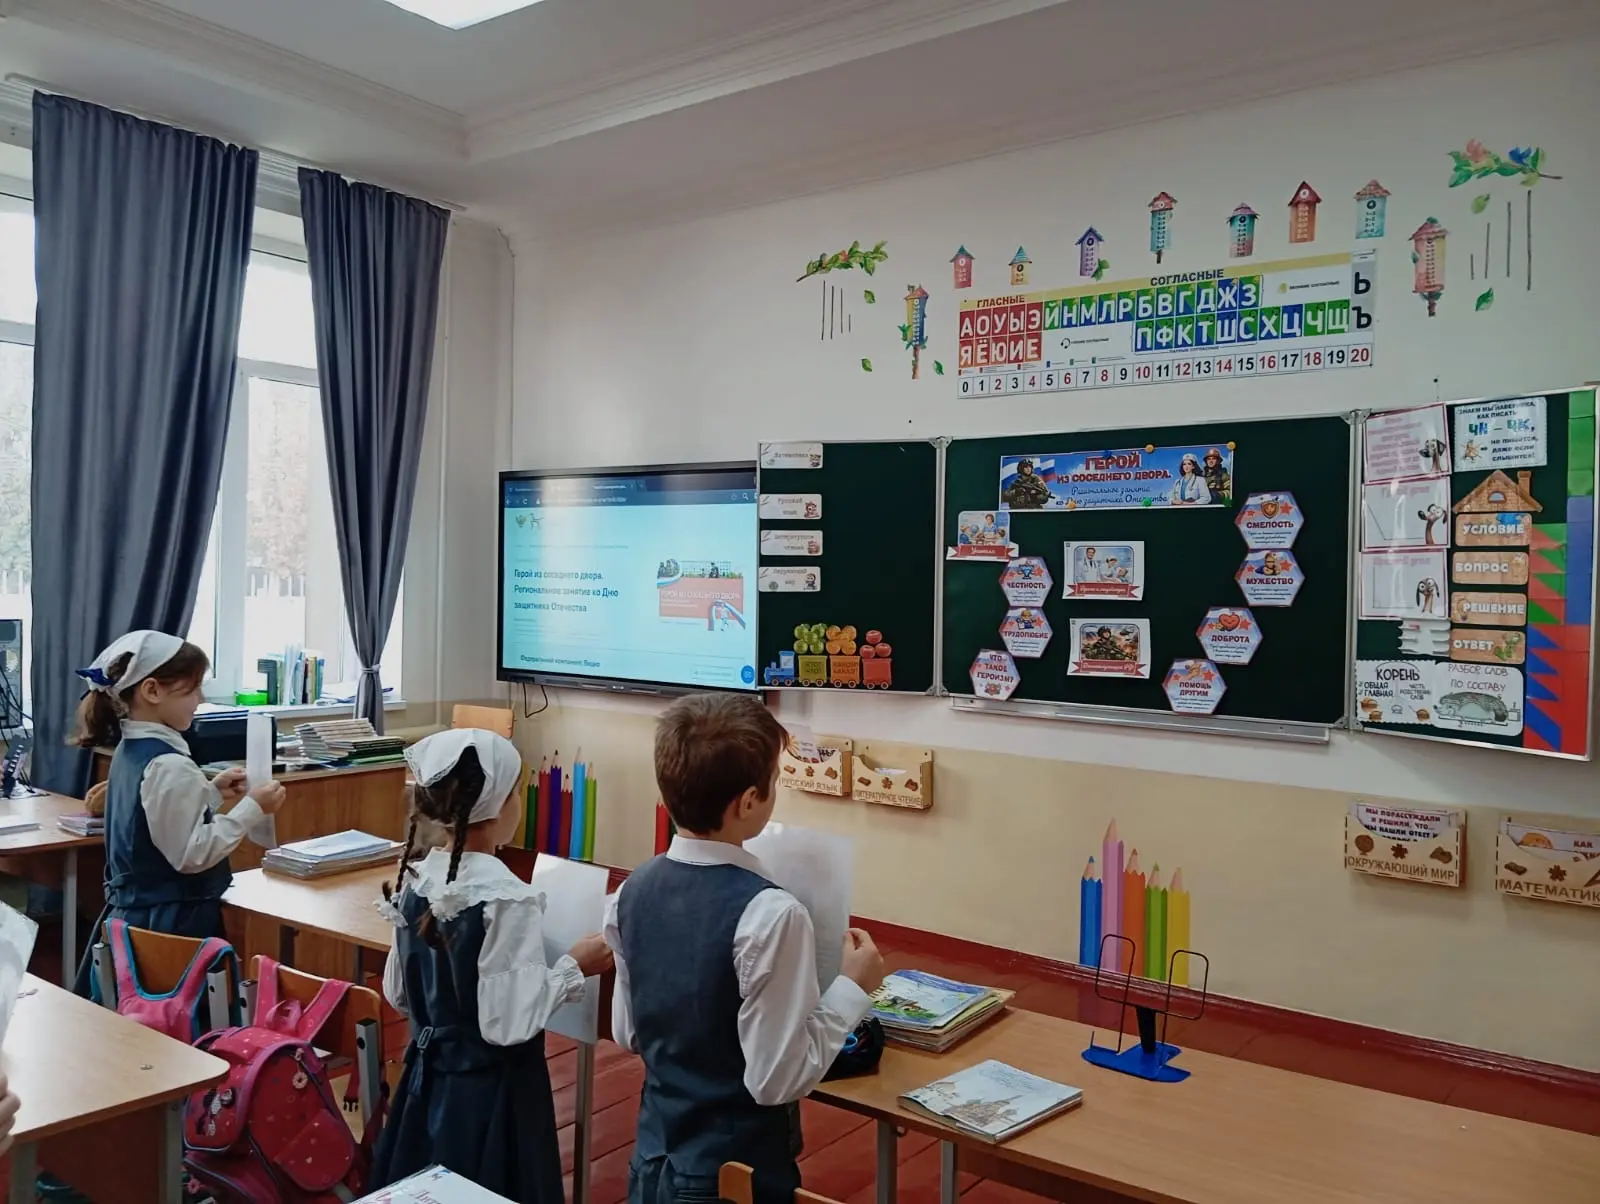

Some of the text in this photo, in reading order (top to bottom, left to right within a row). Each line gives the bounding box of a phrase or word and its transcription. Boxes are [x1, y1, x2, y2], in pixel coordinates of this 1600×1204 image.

[1151, 269, 1224, 286] СОГЛАСНЫЕ
[977, 295, 1025, 308] ГЛАСНЫЕ
[963, 348, 1369, 392] 0 1 2 3 4 5 6 7 8 9 10 11 12 13 14 15 16 17 18 19 20
[1085, 452, 1141, 470] ГЕРОЙ
[1057, 470, 1171, 484] ИЗ СОСЕДНЕГО ДВОРА.
[1247, 521, 1294, 529] СМЕЛОСТЬ
[1464, 523, 1524, 536] УСЛОВИЕ
[1455, 562, 1508, 572] ВОПРОС
[515, 569, 532, 579] Герой
[602, 588, 618, 597] Дню
[1463, 603, 1524, 615] РЕШЕНИЕ
[1004, 631, 1048, 639] ТРУДОЛЮБИЕ
[1211, 635, 1250, 643] ДОБРОТА
[1453, 640, 1494, 650] ОТВЕТ
[985, 663, 1007, 672] ТАКОЕ
[1448, 664, 1508, 676] РАЗБОР СЛОВ
[977, 672, 1014, 683] ГЕРОИЗМ?
[1376, 669, 1420, 680] КОРЕНЬ
[1450, 679, 1506, 692] ПО СОСТАВУ
[781, 778, 838, 791] РУССКИЙ ЯЗЫК
[1381, 811, 1440, 822] ПОРАССУЖДАЛИ
[1380, 827, 1405, 835] НАШЛИ
[1409, 830, 1430, 838] ОТВЕТ
[1348, 856, 1454, 880] ОКРУЖАЮЩИЙ МИР
[1500, 879, 1600, 901] МАТЕМАТИК
